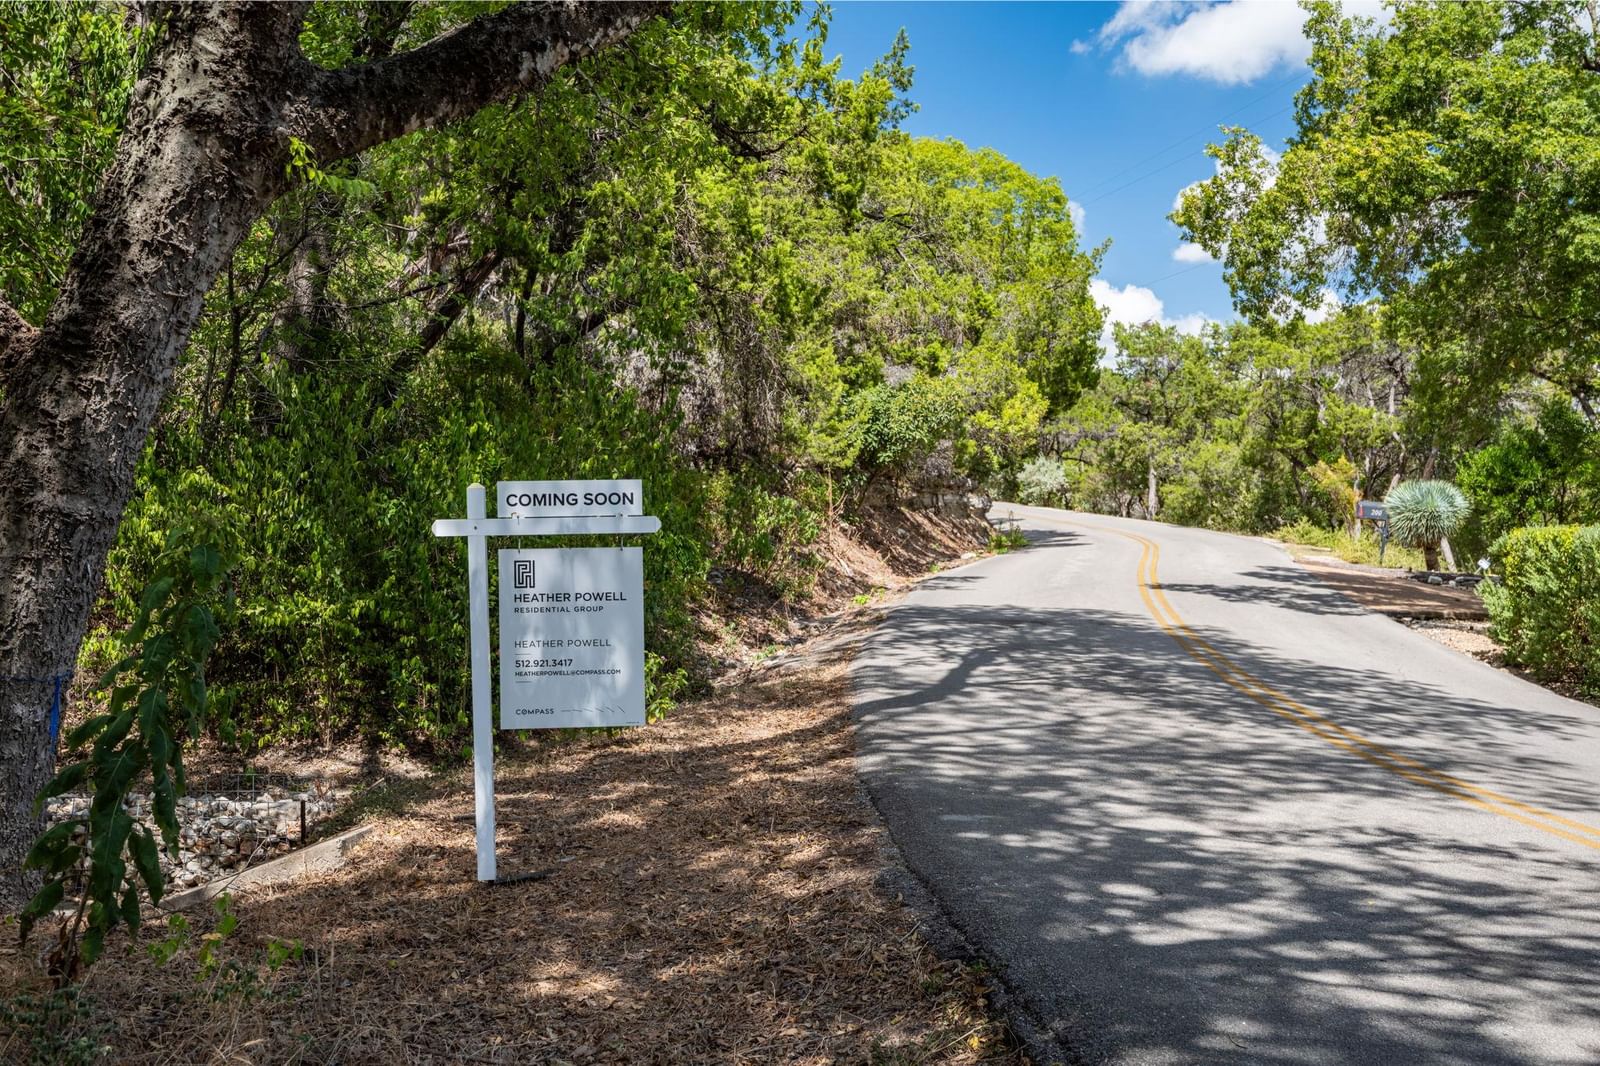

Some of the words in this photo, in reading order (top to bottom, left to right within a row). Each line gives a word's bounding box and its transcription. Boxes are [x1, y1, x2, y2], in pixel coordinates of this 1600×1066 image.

[506, 493, 578, 507] COMING
[584, 492, 634, 506] SOON
[514, 593, 571, 603] HEATHER
[575, 592, 627, 602] POWELL
[514, 606, 571, 614] RESIDENTIAL
[514, 640, 564, 649] HEATHER
[567, 639, 611, 648] POWELL
[515, 659, 573, 668] 512.921.3417
[515, 669, 621, 677] HEATHERPOWELL@COMPASS.COM
